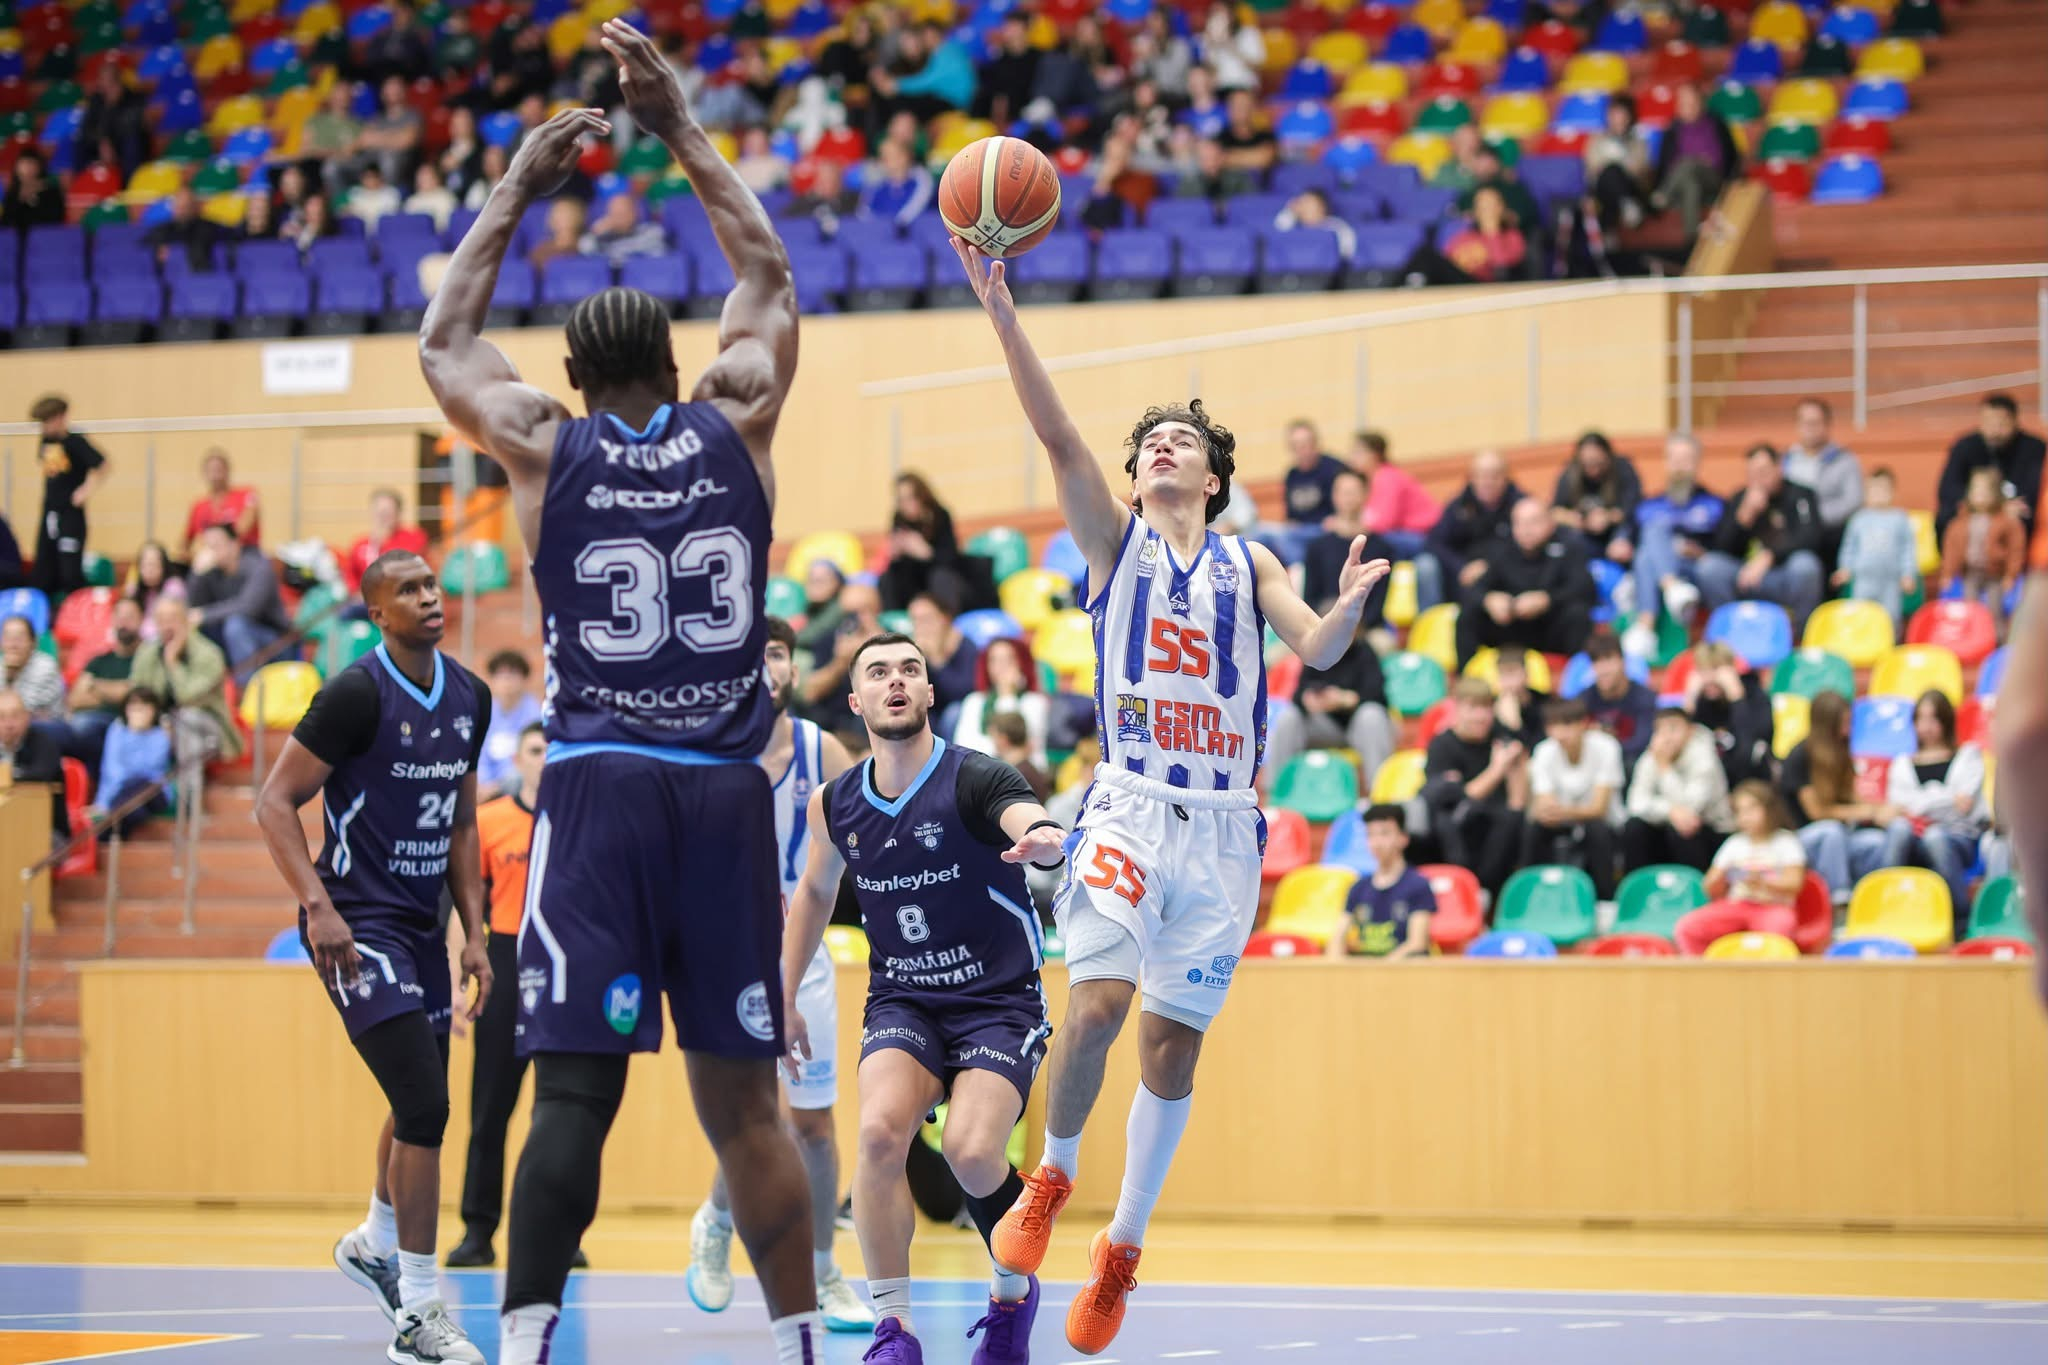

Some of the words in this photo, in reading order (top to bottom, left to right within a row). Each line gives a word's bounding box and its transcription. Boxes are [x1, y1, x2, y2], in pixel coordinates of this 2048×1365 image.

[598, 428, 703, 471] YOUNG
[574, 525, 753, 662] 33
[1148, 617, 1210, 679] 55
[1153, 699, 1222, 731] CSM
[416, 790, 457, 829] 24
[856, 863, 960, 892] Stanleybet
[1083, 843, 1146, 908] 55
[896, 904, 931, 943] 8
[979, 1046, 1017, 1066] Pepper
